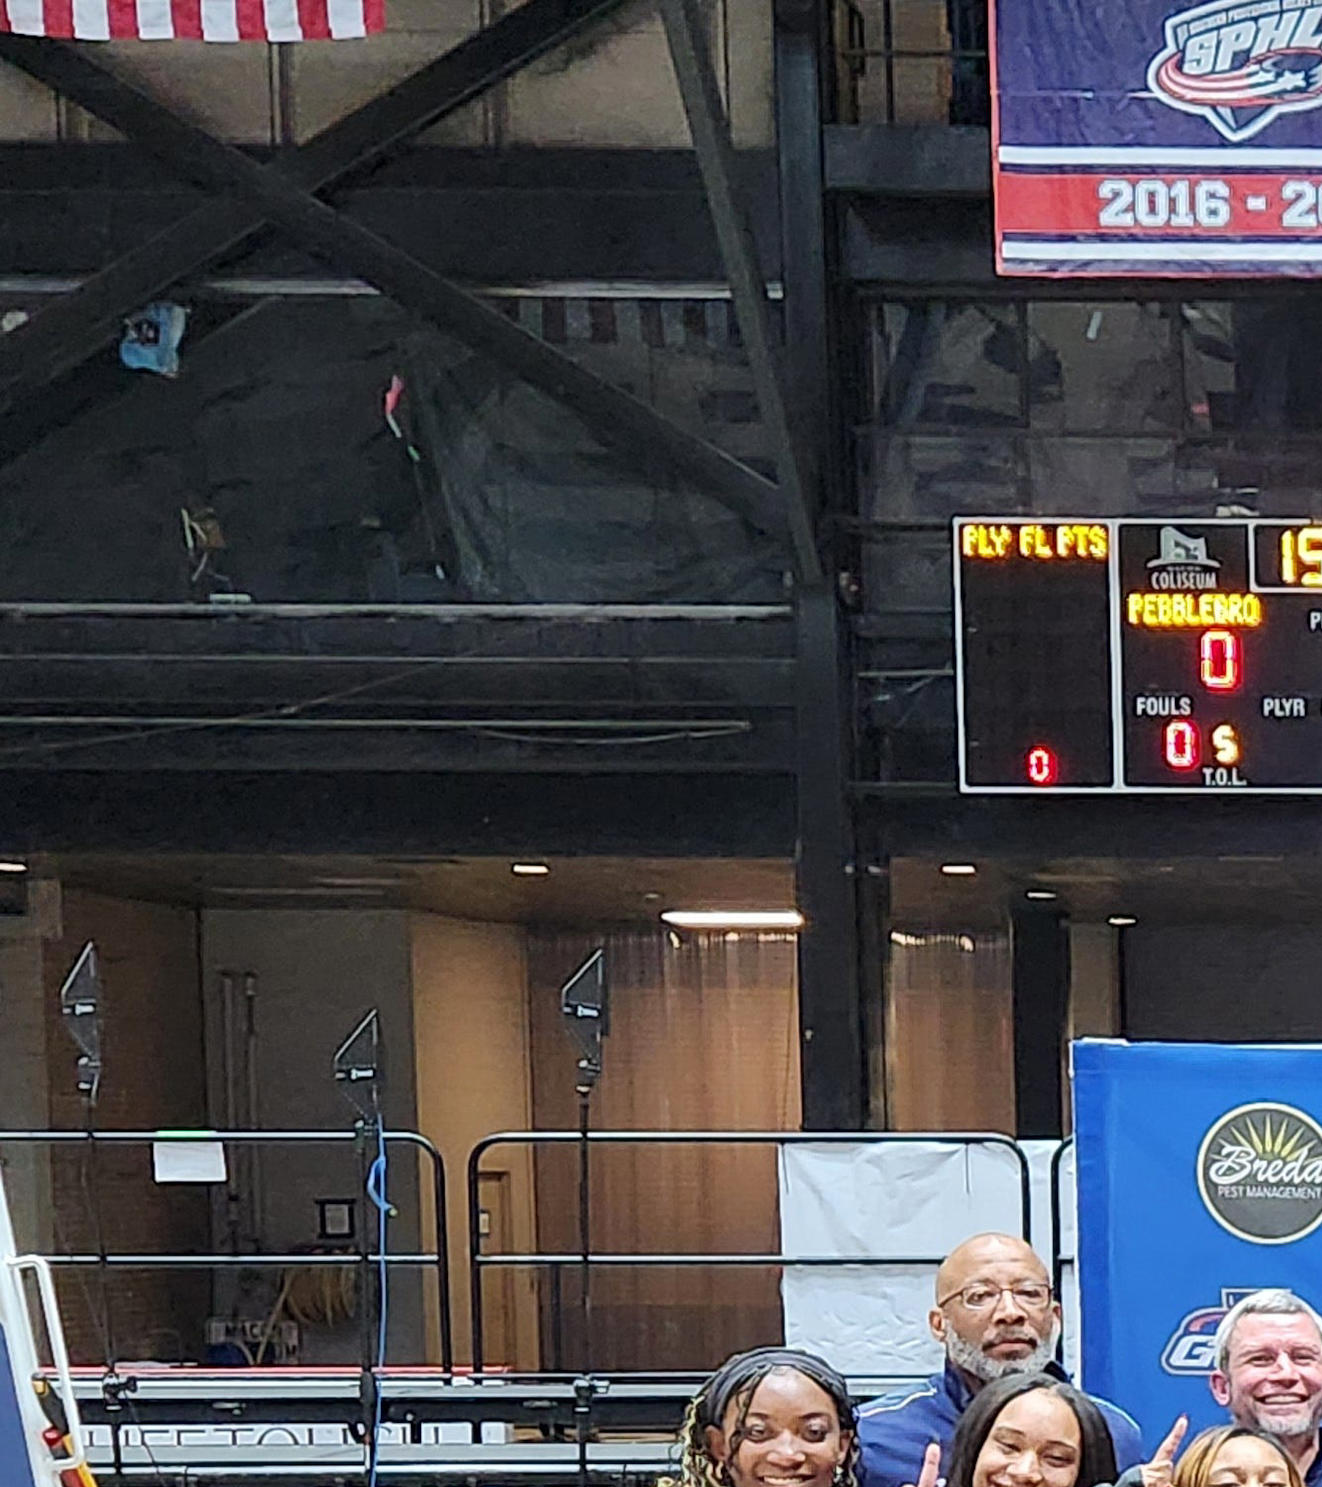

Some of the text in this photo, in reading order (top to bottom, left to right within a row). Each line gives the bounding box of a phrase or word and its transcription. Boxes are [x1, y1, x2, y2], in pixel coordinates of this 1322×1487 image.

[1100, 180, 1231, 227] 2016
[1019, 525, 1052, 558] FL
[1057, 525, 1107, 559] PTS
[1151, 571, 1217, 590] COLISEUM
[1201, 630, 1237, 688] 0
[1136, 697, 1191, 716] FOULS
[1263, 698, 1305, 717] PLYR
[1166, 721, 1195, 767] 0
[1029, 748, 1052, 783] 0
[1202, 768, 1247, 786] T.O.L.
[1218, 1185, 1322, 1199] PEST MANAGEMENT
